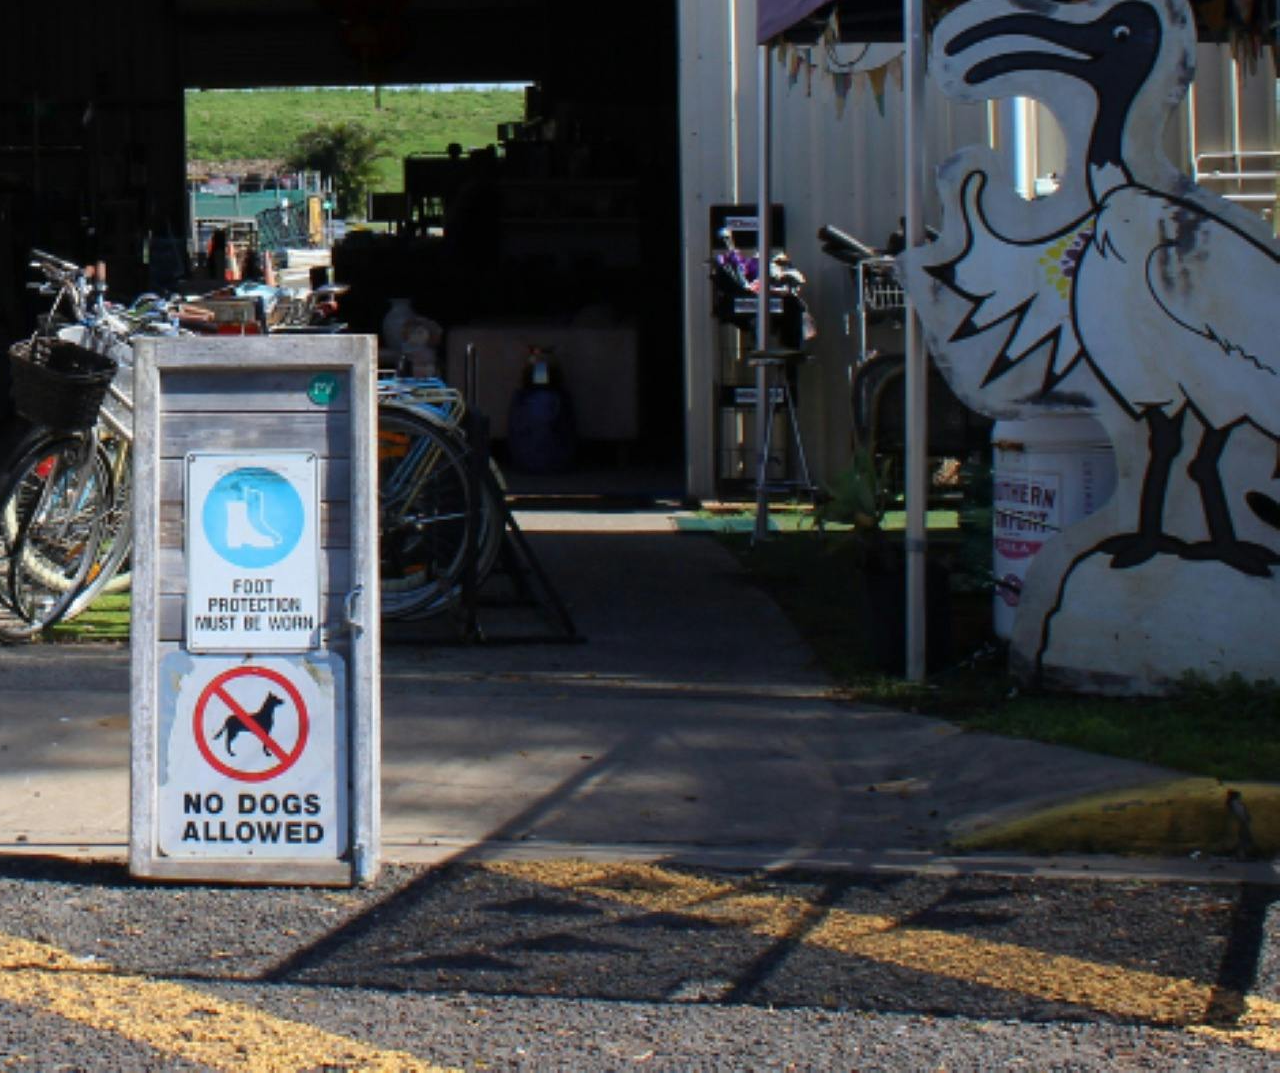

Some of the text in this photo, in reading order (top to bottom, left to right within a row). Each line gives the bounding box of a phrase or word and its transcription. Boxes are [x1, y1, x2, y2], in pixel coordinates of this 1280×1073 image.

[233, 579, 274, 594] FOOT
[208, 598, 302, 612] PROTECTION
[195, 615, 313, 631] MUST BE WORN
[183, 793, 322, 815] NO DOGS
[181, 821, 325, 843] ALLOWED
